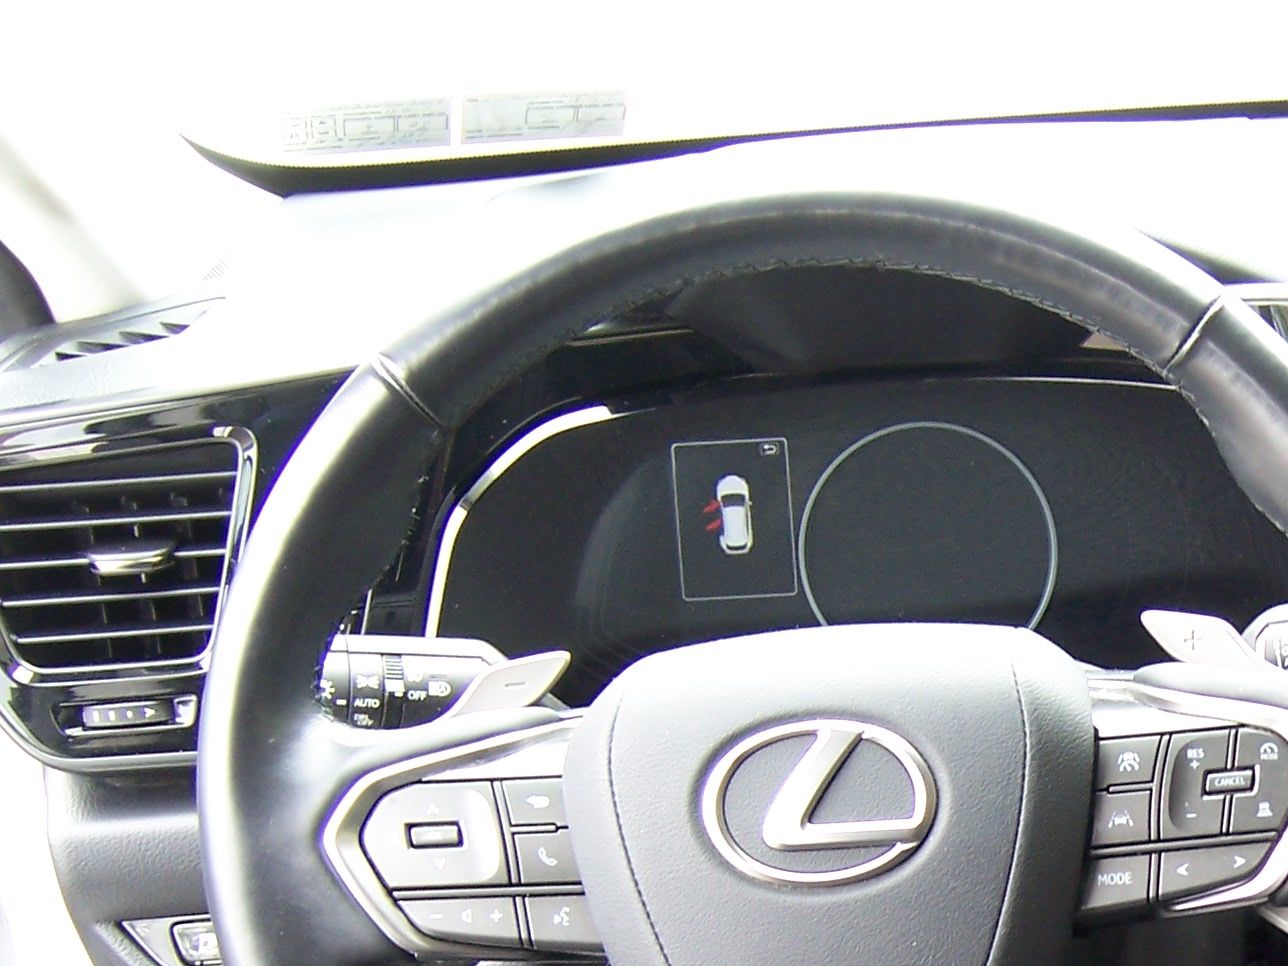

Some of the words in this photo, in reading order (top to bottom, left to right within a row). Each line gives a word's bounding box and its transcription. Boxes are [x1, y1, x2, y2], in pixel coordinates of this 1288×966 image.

[407, 690, 428, 701] OFF
[354, 698, 380, 709] AUTO
[1186, 748, 1205, 759] RES
[1214, 776, 1246, 787] CANCEL
[1097, 872, 1132, 886] MODE
